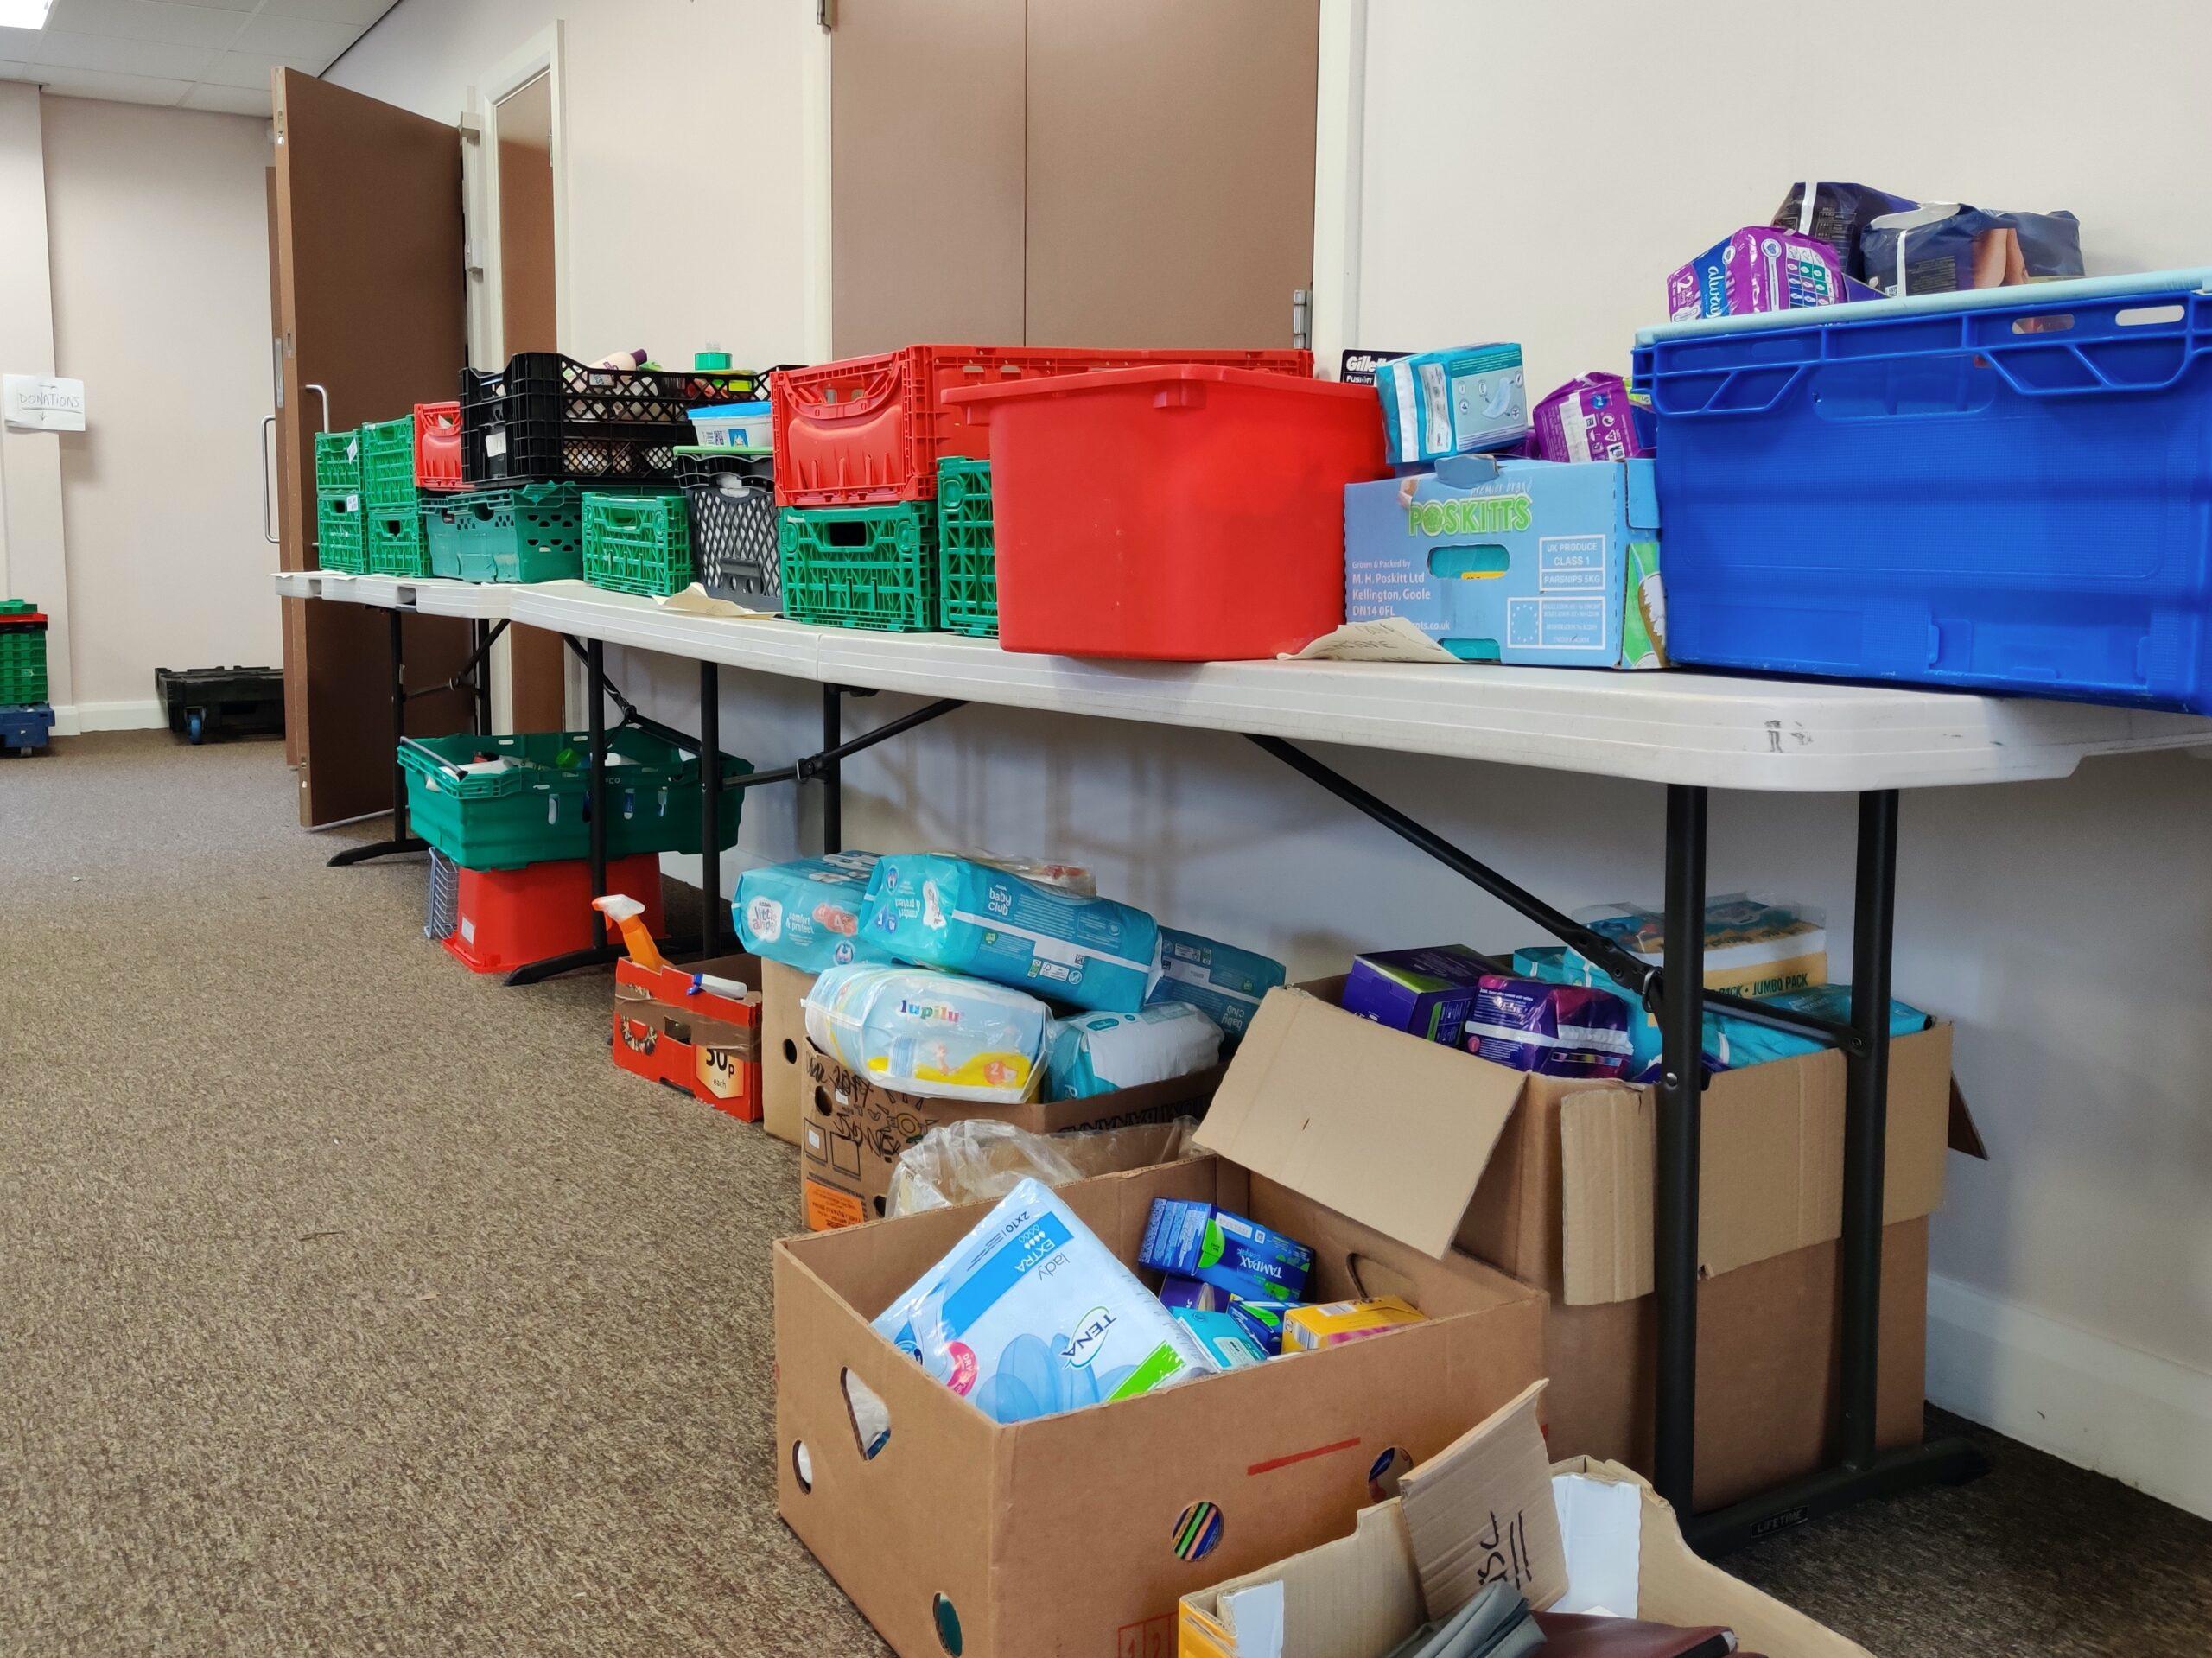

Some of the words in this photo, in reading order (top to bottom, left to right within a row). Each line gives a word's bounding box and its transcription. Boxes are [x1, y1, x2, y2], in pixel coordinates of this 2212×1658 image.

[1706, 265, 1726, 318] alway
[1346, 355, 1388, 372] Gillet
[1408, 493, 1533, 537] POSKITTS
[1547, 543, 1558, 553] UK
[1559, 543, 1598, 552] PRODUCE
[1554, 556, 1584, 567] CLASS
[1376, 572, 1408, 584] Poskitt
[1409, 571, 1425, 584] Ltd
[1544, 575, 1583, 584] PARSNIPS
[1584, 574, 1601, 583] 5KG
[1352, 588, 1402, 602] Kellington,
[1402, 588, 1432, 600] Goole
[1352, 606, 1377, 616] DN14
[989, 886, 1012, 906] baby
[788, 912, 810, 925] comfort
[1752, 977, 1783, 996] JUMBO
[1785, 973, 1808, 989] PACK
[900, 1000, 959, 1023] lupilu
[714, 1079, 726, 1089] each
[1014, 1238, 1056, 1273] EXTRA
[1037, 1252, 1071, 1281] lady
[1239, 1255, 1282, 1280] TAMPAX
[1061, 1313, 1117, 1358] TENA
